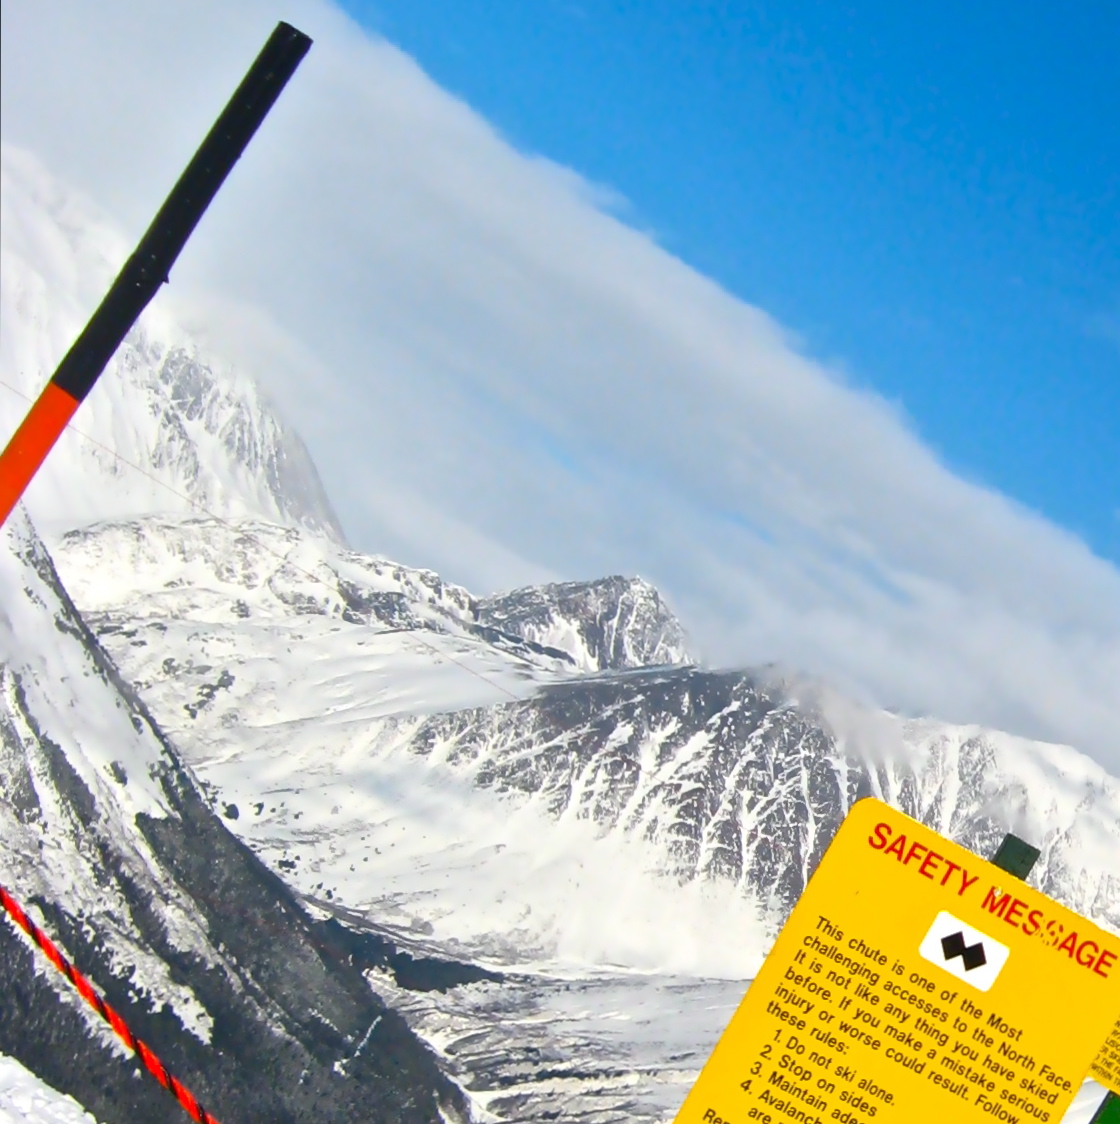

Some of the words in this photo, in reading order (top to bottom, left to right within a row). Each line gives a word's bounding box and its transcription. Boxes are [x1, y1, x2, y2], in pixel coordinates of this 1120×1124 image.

[868, 822, 980, 897] SAFETY
[803, 935, 881, 987] challenging
[883, 980, 949, 1023] accesses
[952, 1016, 968, 1033] to
[971, 1027, 995, 1048] the
[997, 1041, 1036, 1072] North
[1038, 1064, 1072, 1094] Face.
[815, 915, 845, 942] This
[848, 938, 888, 966] chute
[891, 959, 906, 976] is
[908, 972, 936, 993] one
[940, 989, 959, 1004] of
[959, 998, 983, 1020] the
[986, 1012, 1023, 1042] Most
[766, 1000, 807, 1031] these
[809, 1027, 850, 1056] rules:
[774, 982, 816, 1015] injury
[818, 1010, 836, 1024] or
[838, 1020, 882, 1051] worse
[885, 1047, 927, 1075] could
[927, 1070, 969, 1101] result.
[783, 965, 833, 1004] before.
[838, 995, 853, 1011] If
[852, 1007, 881, 1029] you
[883, 1024, 923, 1052] make
[926, 1048, 938, 1060] a
[940, 1055, 996, 1093] mistake
[999, 1088, 1051, 1123] serious
[793, 948, 807, 965] It
[808, 957, 823, 974] is
[825, 970, 852, 990] not
[853, 982, 880, 1006] like
[883, 1002, 911, 1024] any
[914, 1016, 950, 1047] thing
[951, 1040, 980, 1062] you
[981, 1054, 1016, 1082] have
[1019, 1078, 1060, 1105] skied
[739, 1079, 753, 1095] 4.
[749, 1060, 763, 1078] 3.
[767, 1070, 828, 1112] Maintain
[759, 1044, 773, 1061] 2.
[777, 1053, 813, 1082] Stop
[816, 1078, 836, 1094] on
[838, 1090, 878, 1118] sides
[773, 1028, 783, 1044] 1.
[785, 1035, 806, 1056] Do
[808, 1051, 833, 1070] not
[834, 1065, 857, 1083] ski
[857, 1078, 895, 1106] alone.
